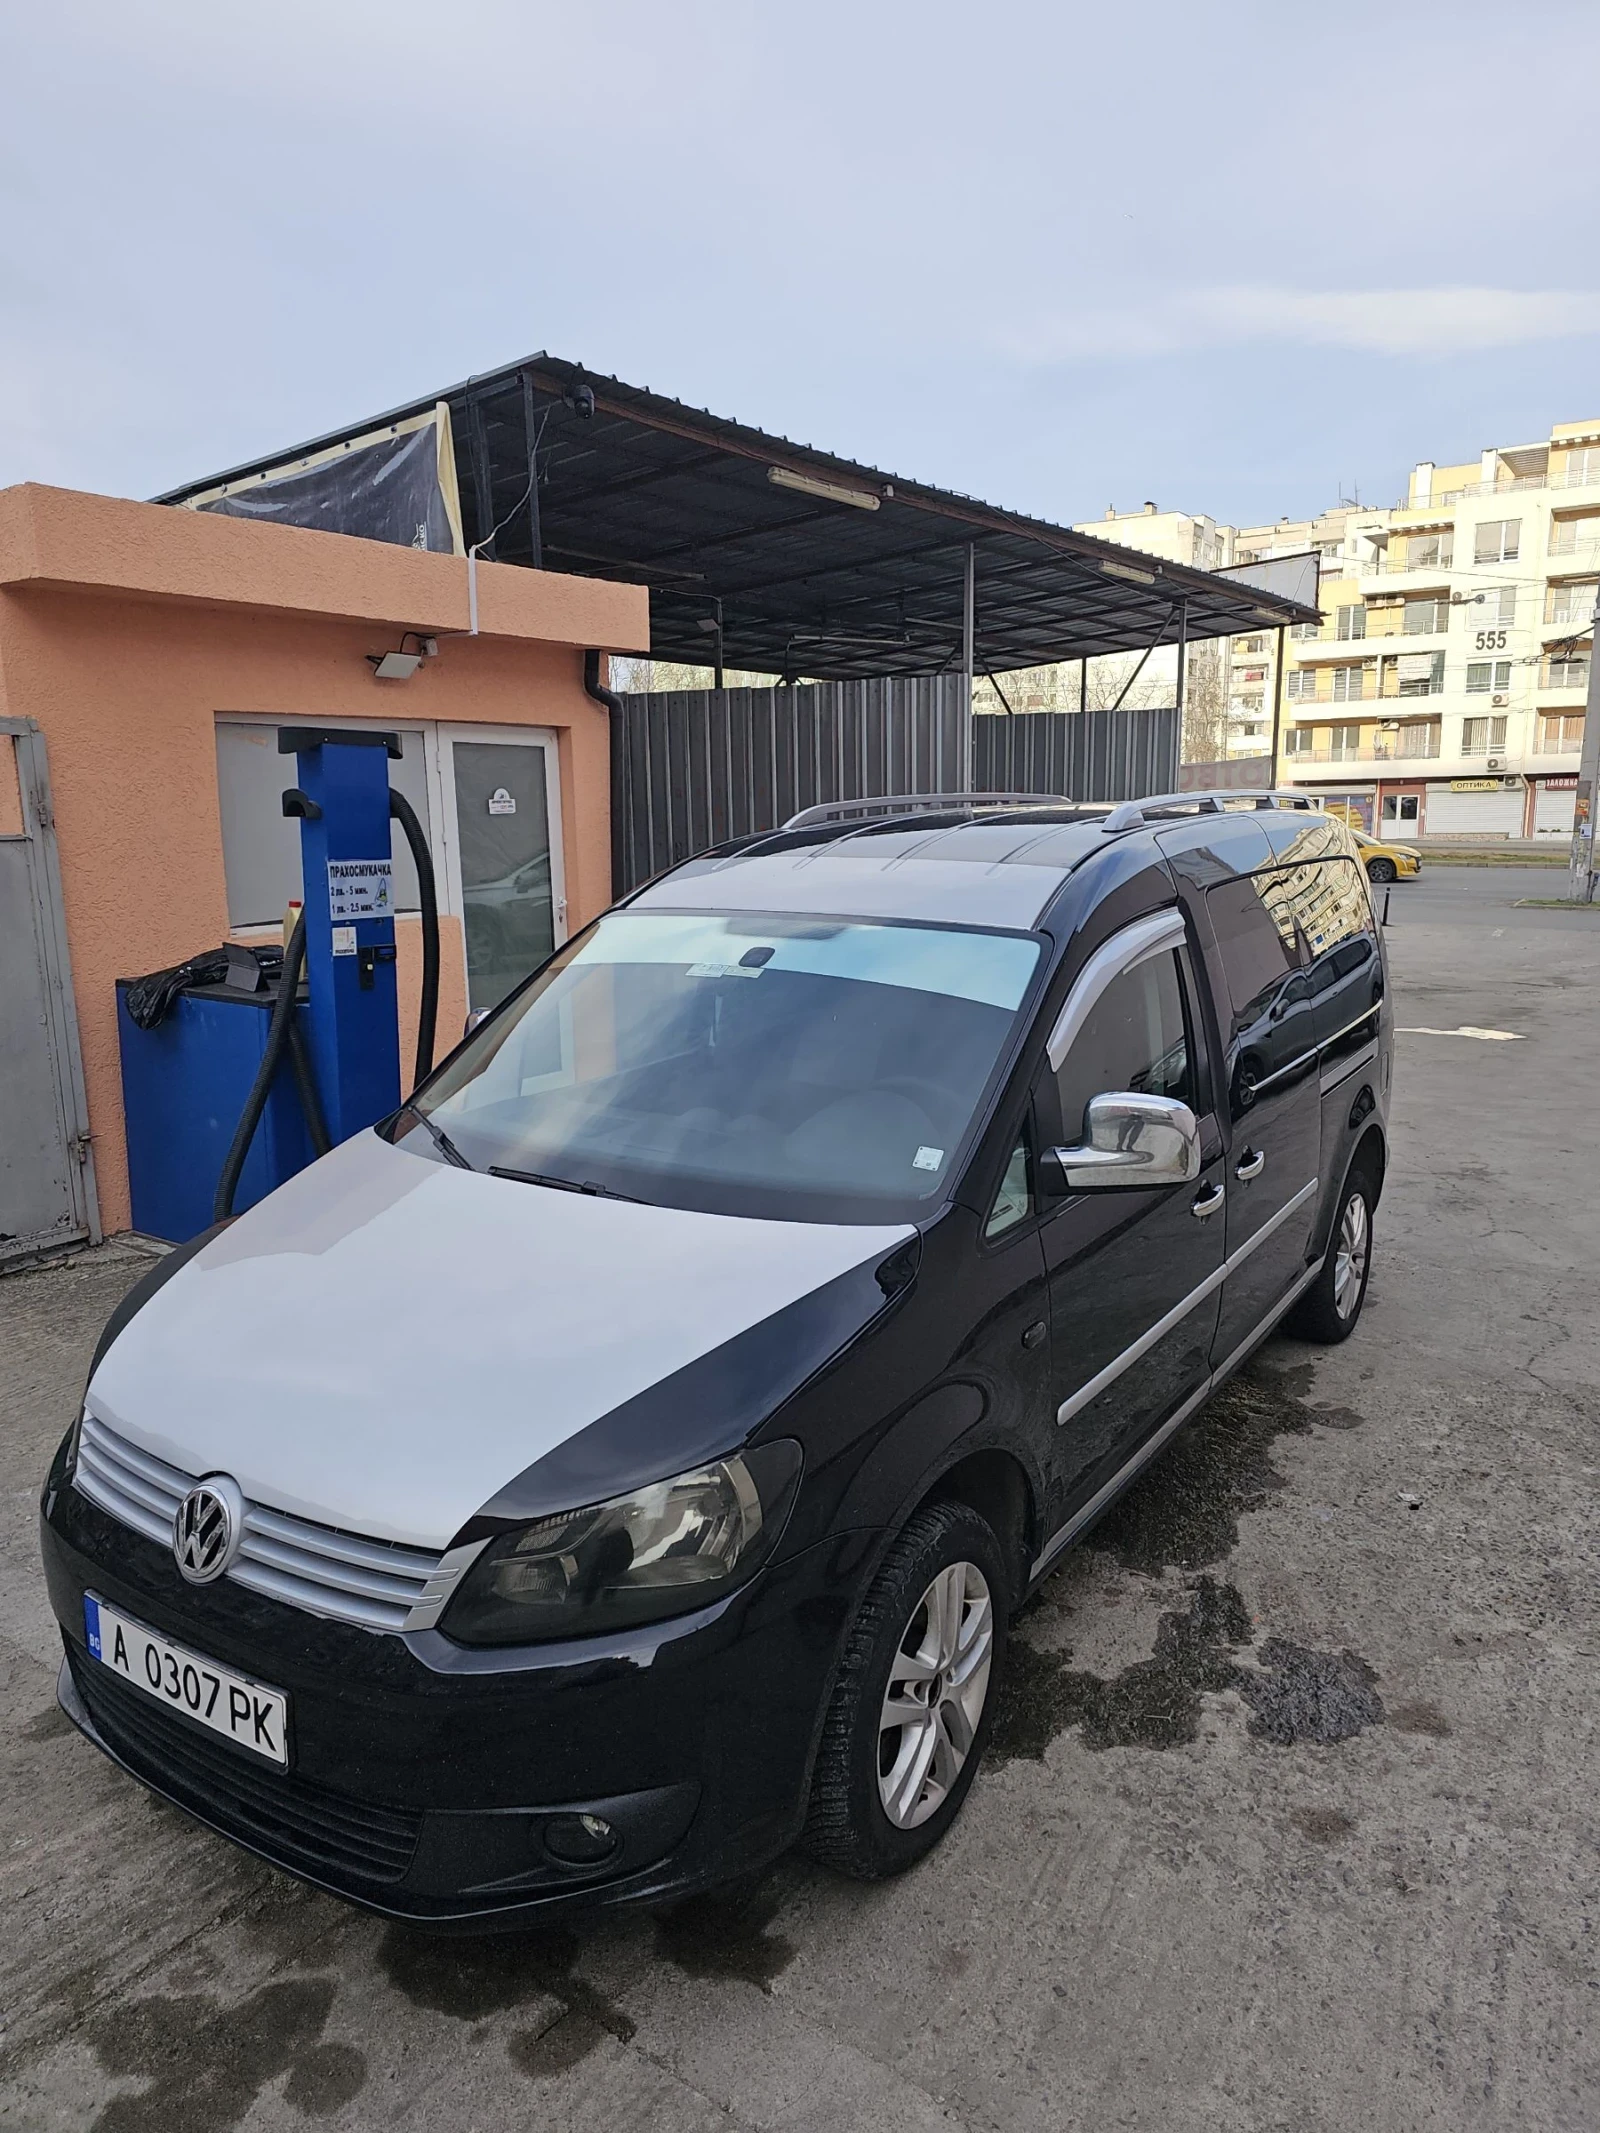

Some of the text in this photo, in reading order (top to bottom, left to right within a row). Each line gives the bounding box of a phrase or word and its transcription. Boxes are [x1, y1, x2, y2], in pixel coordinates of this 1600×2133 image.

[1475, 631, 1506, 650] 555
[330, 864, 391, 878] ПРАХОСМУКАЧКА
[330, 886, 335, 896] 2
[349, 885, 354, 895] 5
[354, 887, 368, 895] мин.
[89, 1633, 100, 1650] BG
[113, 1624, 277, 1752] A 0307 PK
